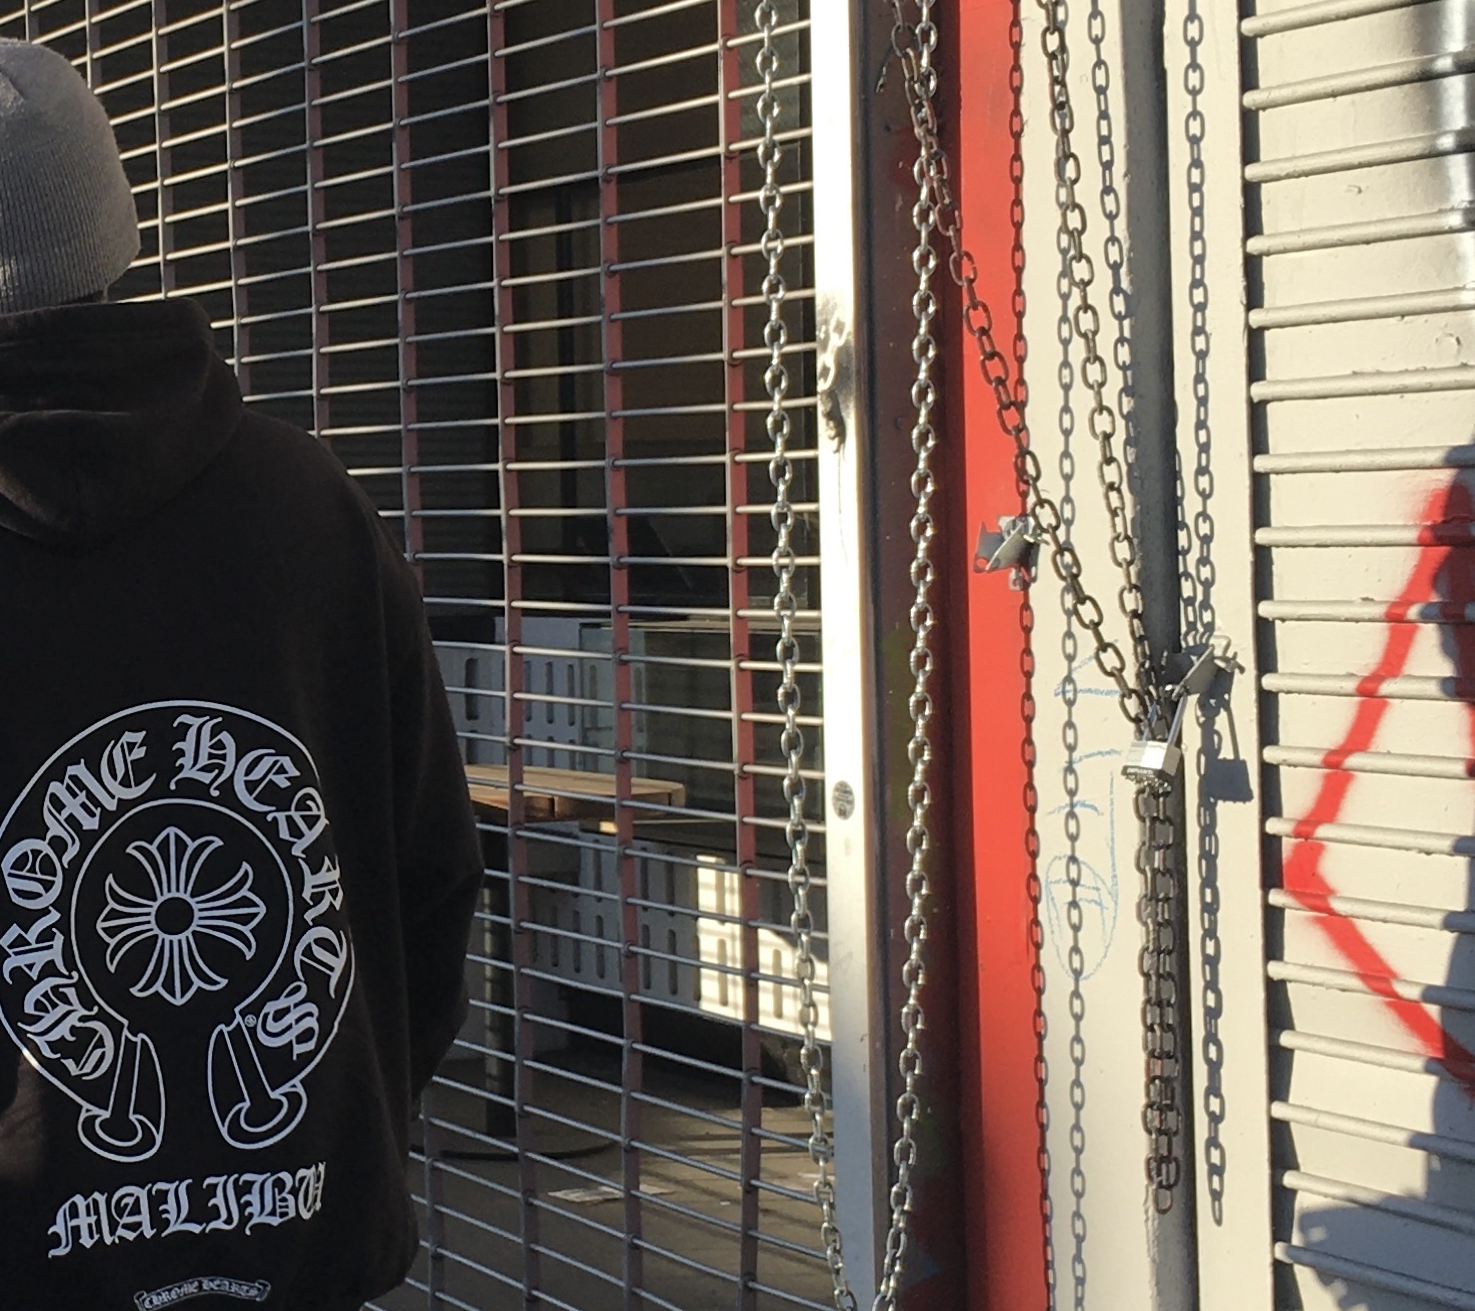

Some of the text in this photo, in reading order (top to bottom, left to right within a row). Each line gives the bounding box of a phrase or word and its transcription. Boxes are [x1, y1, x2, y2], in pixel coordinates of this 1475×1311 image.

[0, 714, 348, 1080] CHROME HEARTS
[47, 1161, 326, 1258] MALIBU
